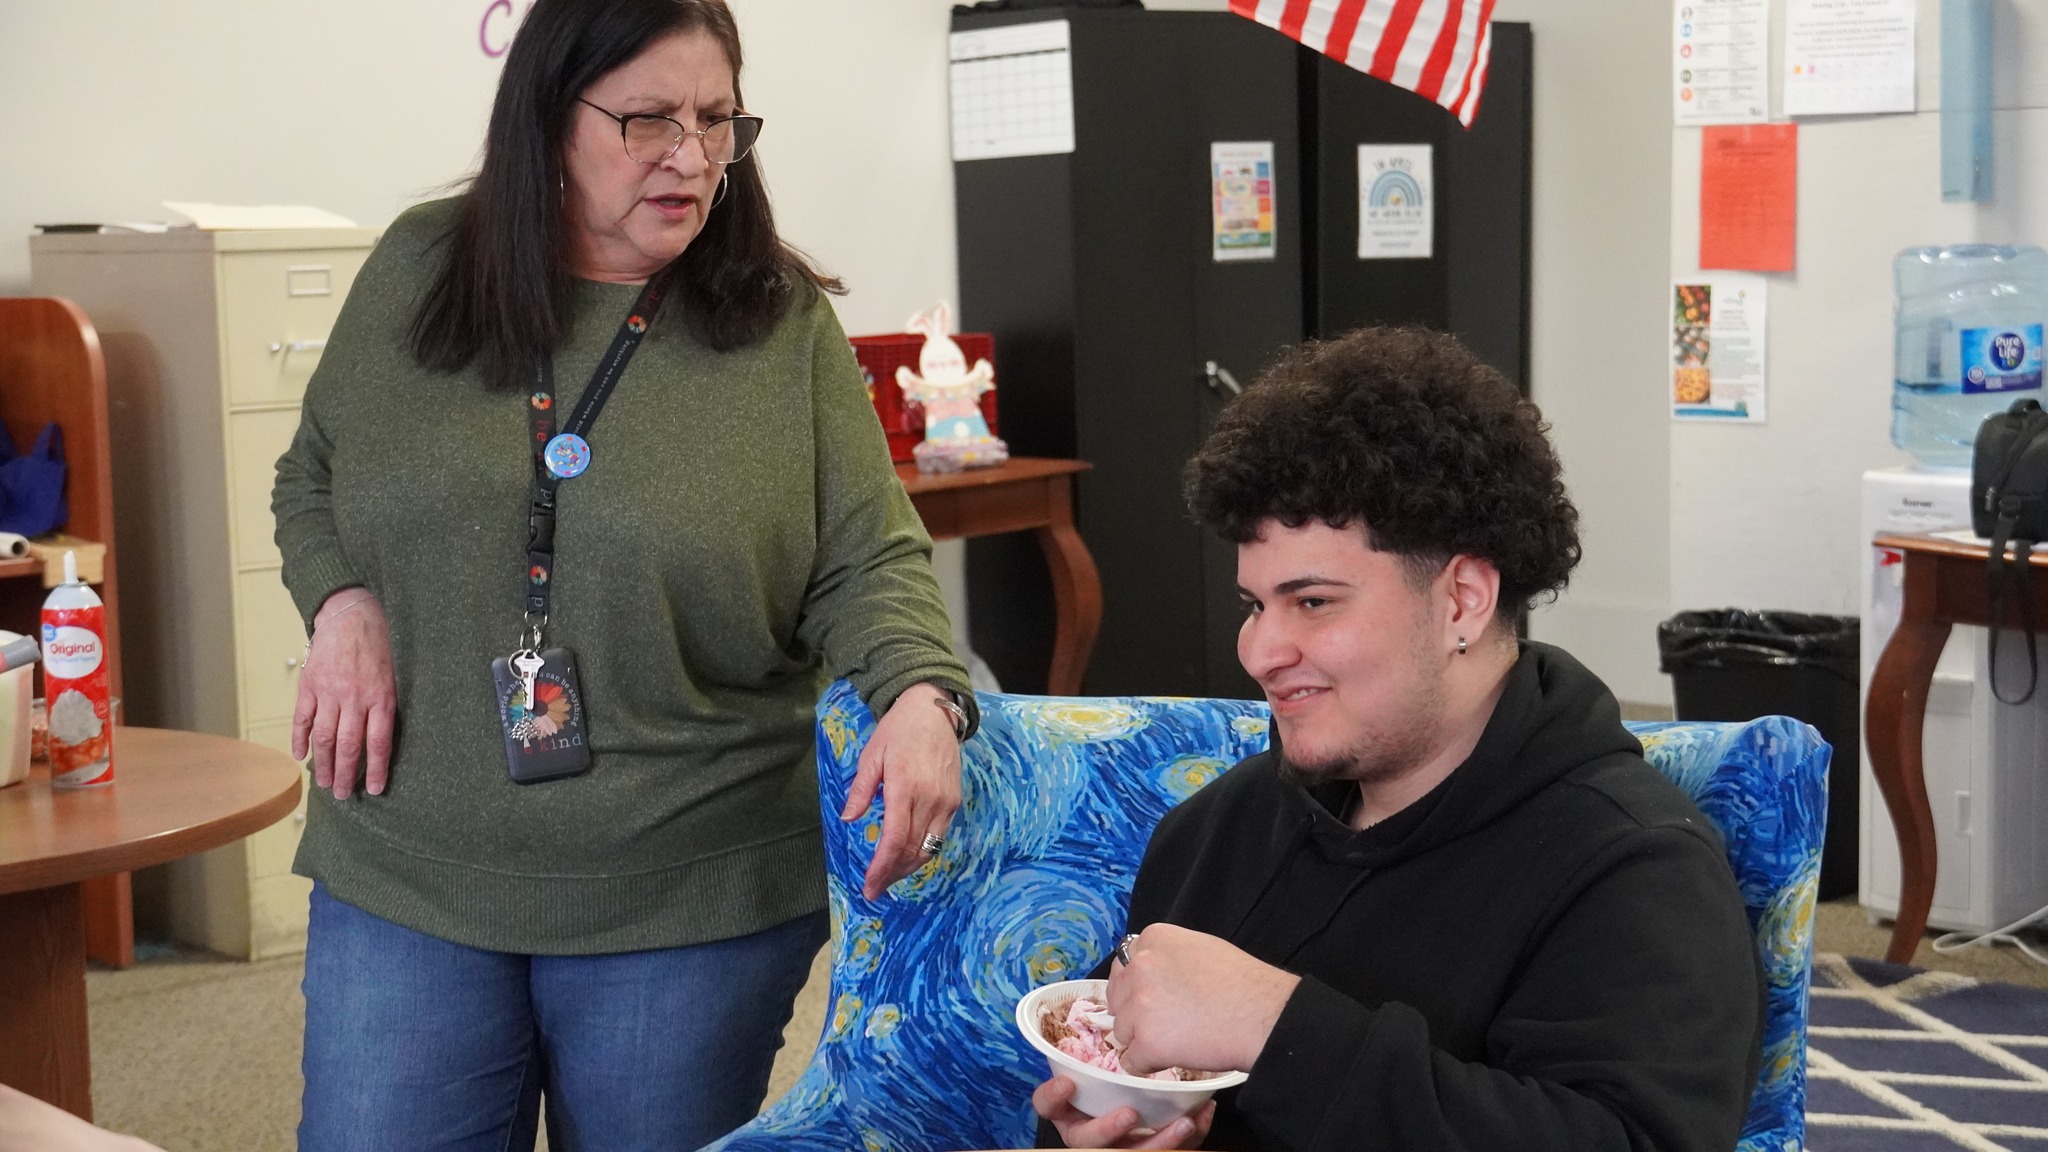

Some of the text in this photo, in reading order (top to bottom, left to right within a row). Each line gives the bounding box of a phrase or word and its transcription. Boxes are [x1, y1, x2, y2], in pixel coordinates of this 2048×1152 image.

[1995, 336, 2021, 348] Pure
[1998, 346, 2018, 358] Life
[50, 641, 96, 657] Original
[546, 672, 560, 682] can
[561, 679, 570, 689] be
[568, 688, 581, 728] anything
